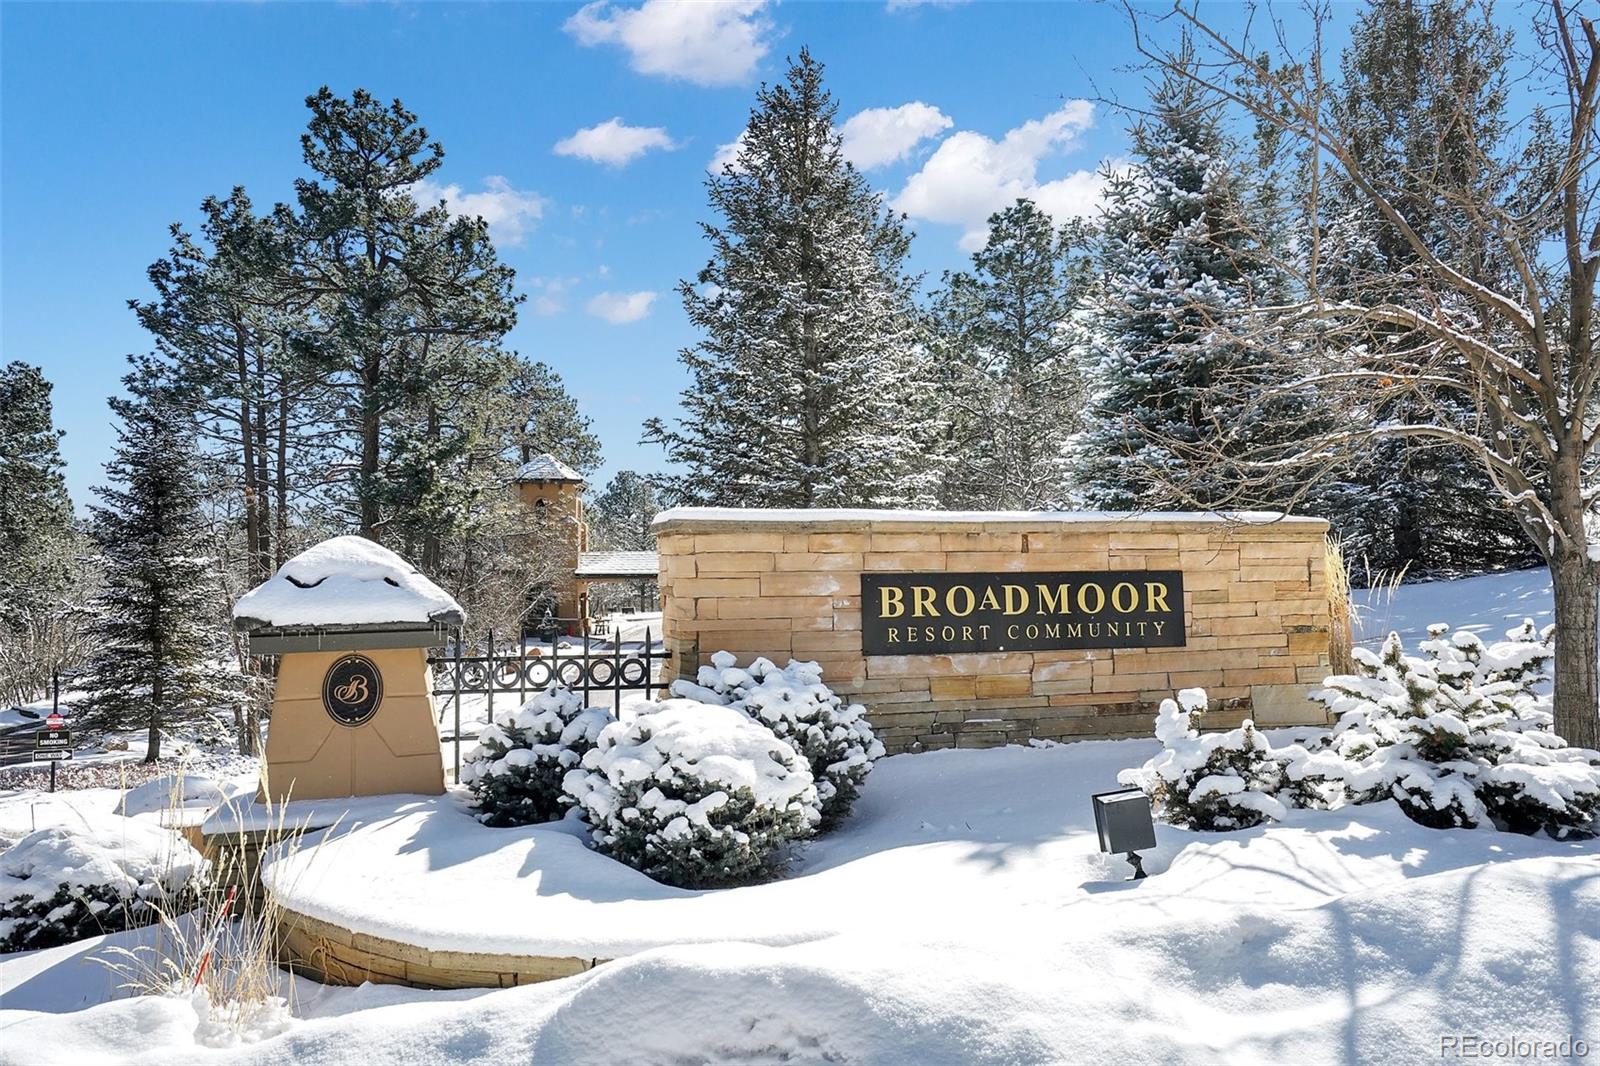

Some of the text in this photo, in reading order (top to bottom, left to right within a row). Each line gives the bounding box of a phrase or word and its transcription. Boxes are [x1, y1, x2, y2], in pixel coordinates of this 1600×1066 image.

[878, 582, 1172, 618] BROADMOOR
[887, 620, 1167, 643] RESORT COMMUNITY
